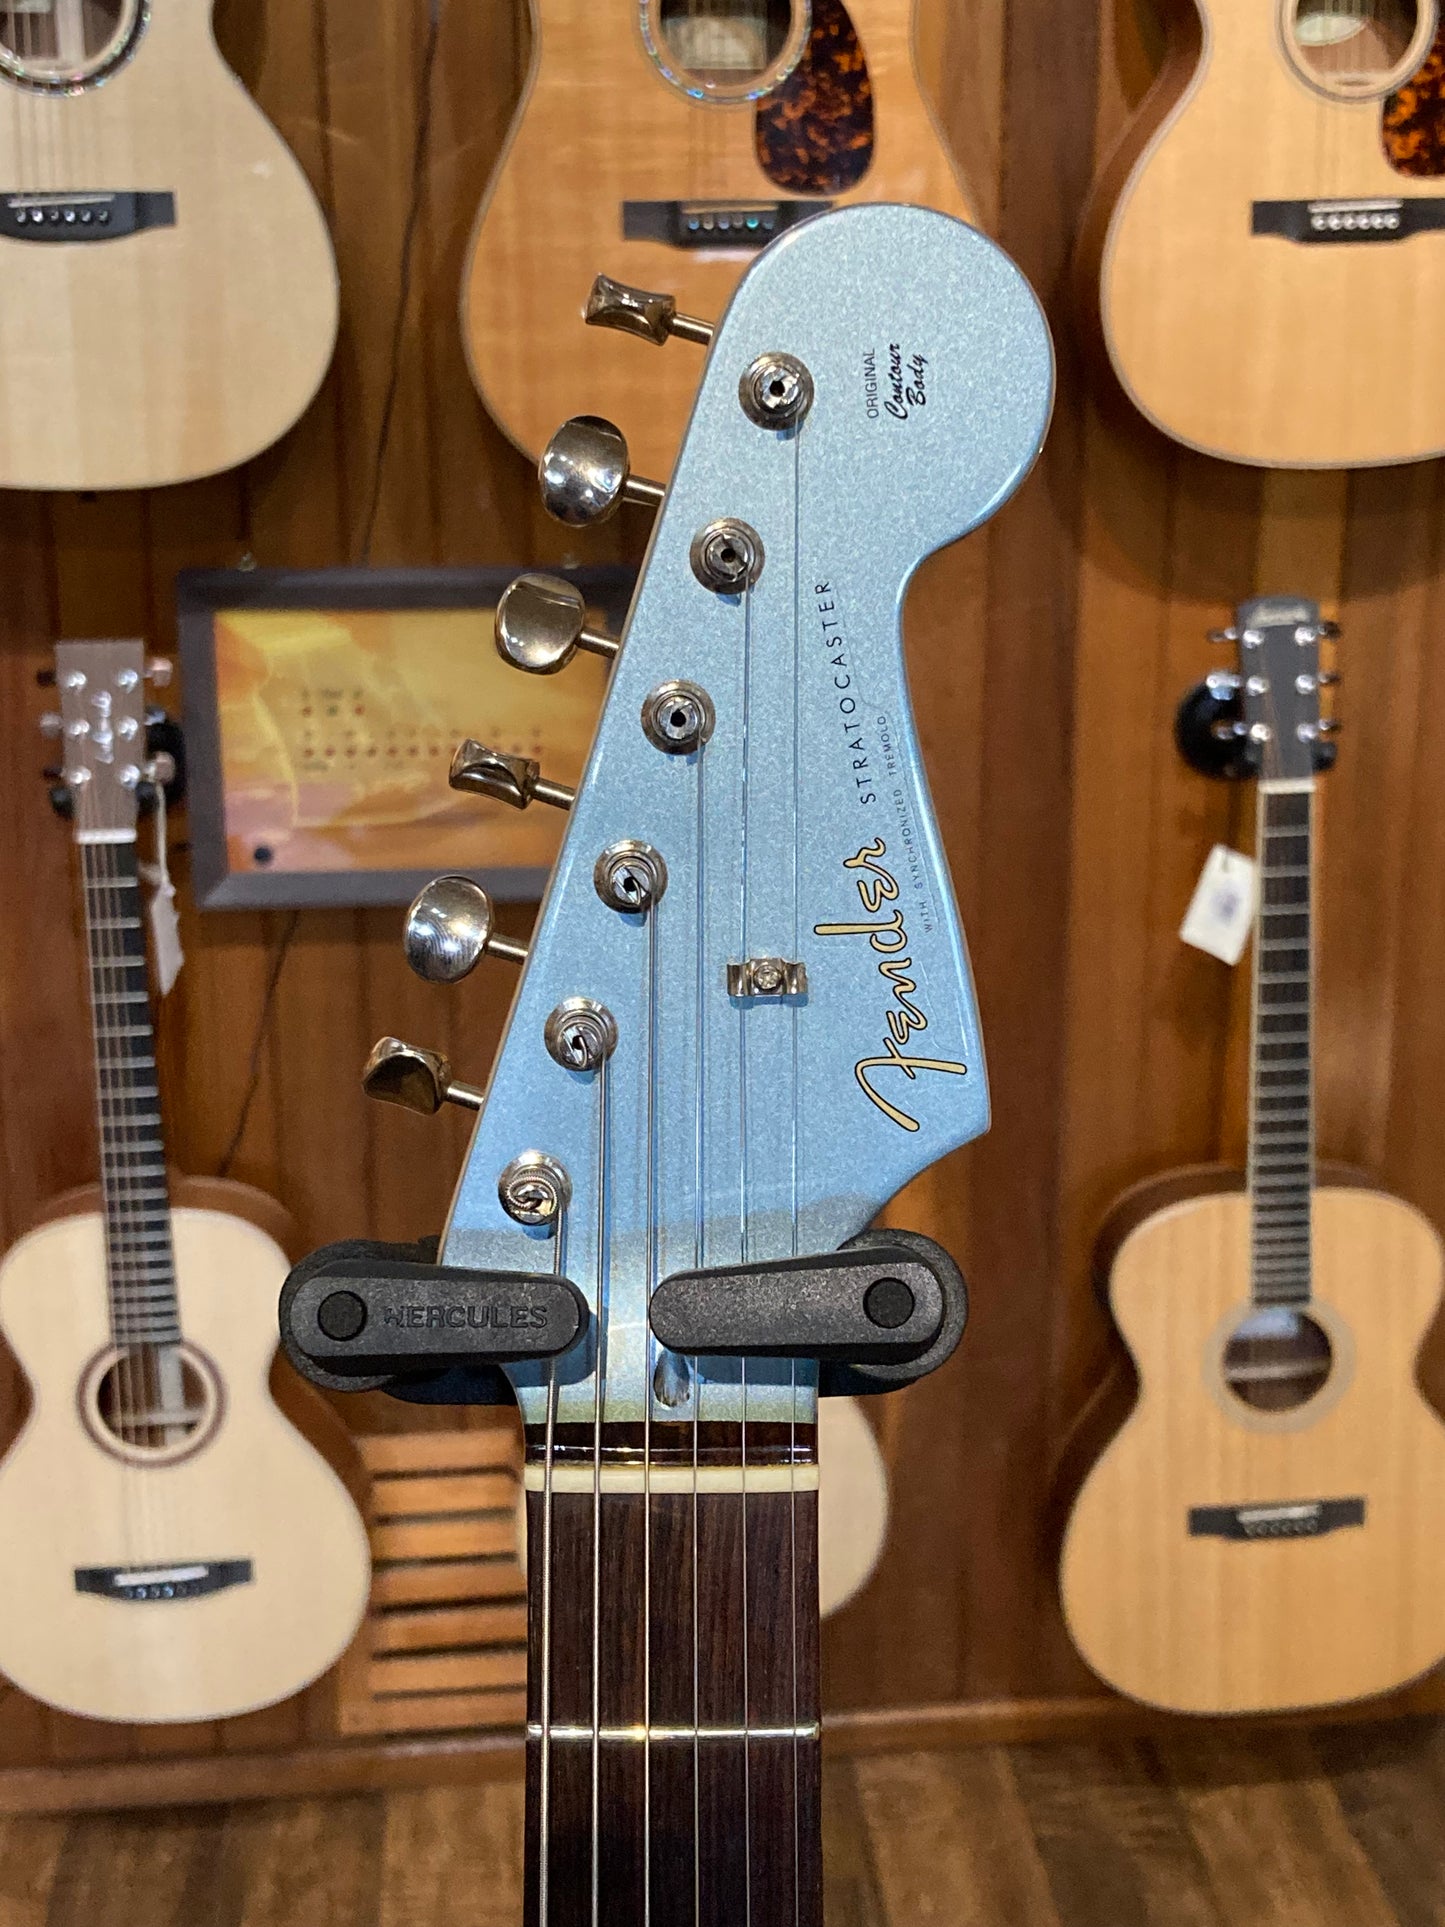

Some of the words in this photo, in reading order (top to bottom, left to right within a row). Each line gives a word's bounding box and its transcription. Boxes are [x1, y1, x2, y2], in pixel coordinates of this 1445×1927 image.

[863, 347, 879, 419] ORIGINAL
[884, 343, 908, 419] Contour
[905, 354, 928, 406] Body
[815, 581, 876, 804] STRATOCASTER
[877, 715, 897, 776] TREMOLO
[896, 788, 923, 889] SYNCHRONIZED
[915, 901, 933, 933] WITH
[814, 837, 968, 1132] Fender
[384, 1305, 548, 1329] HERCULES
